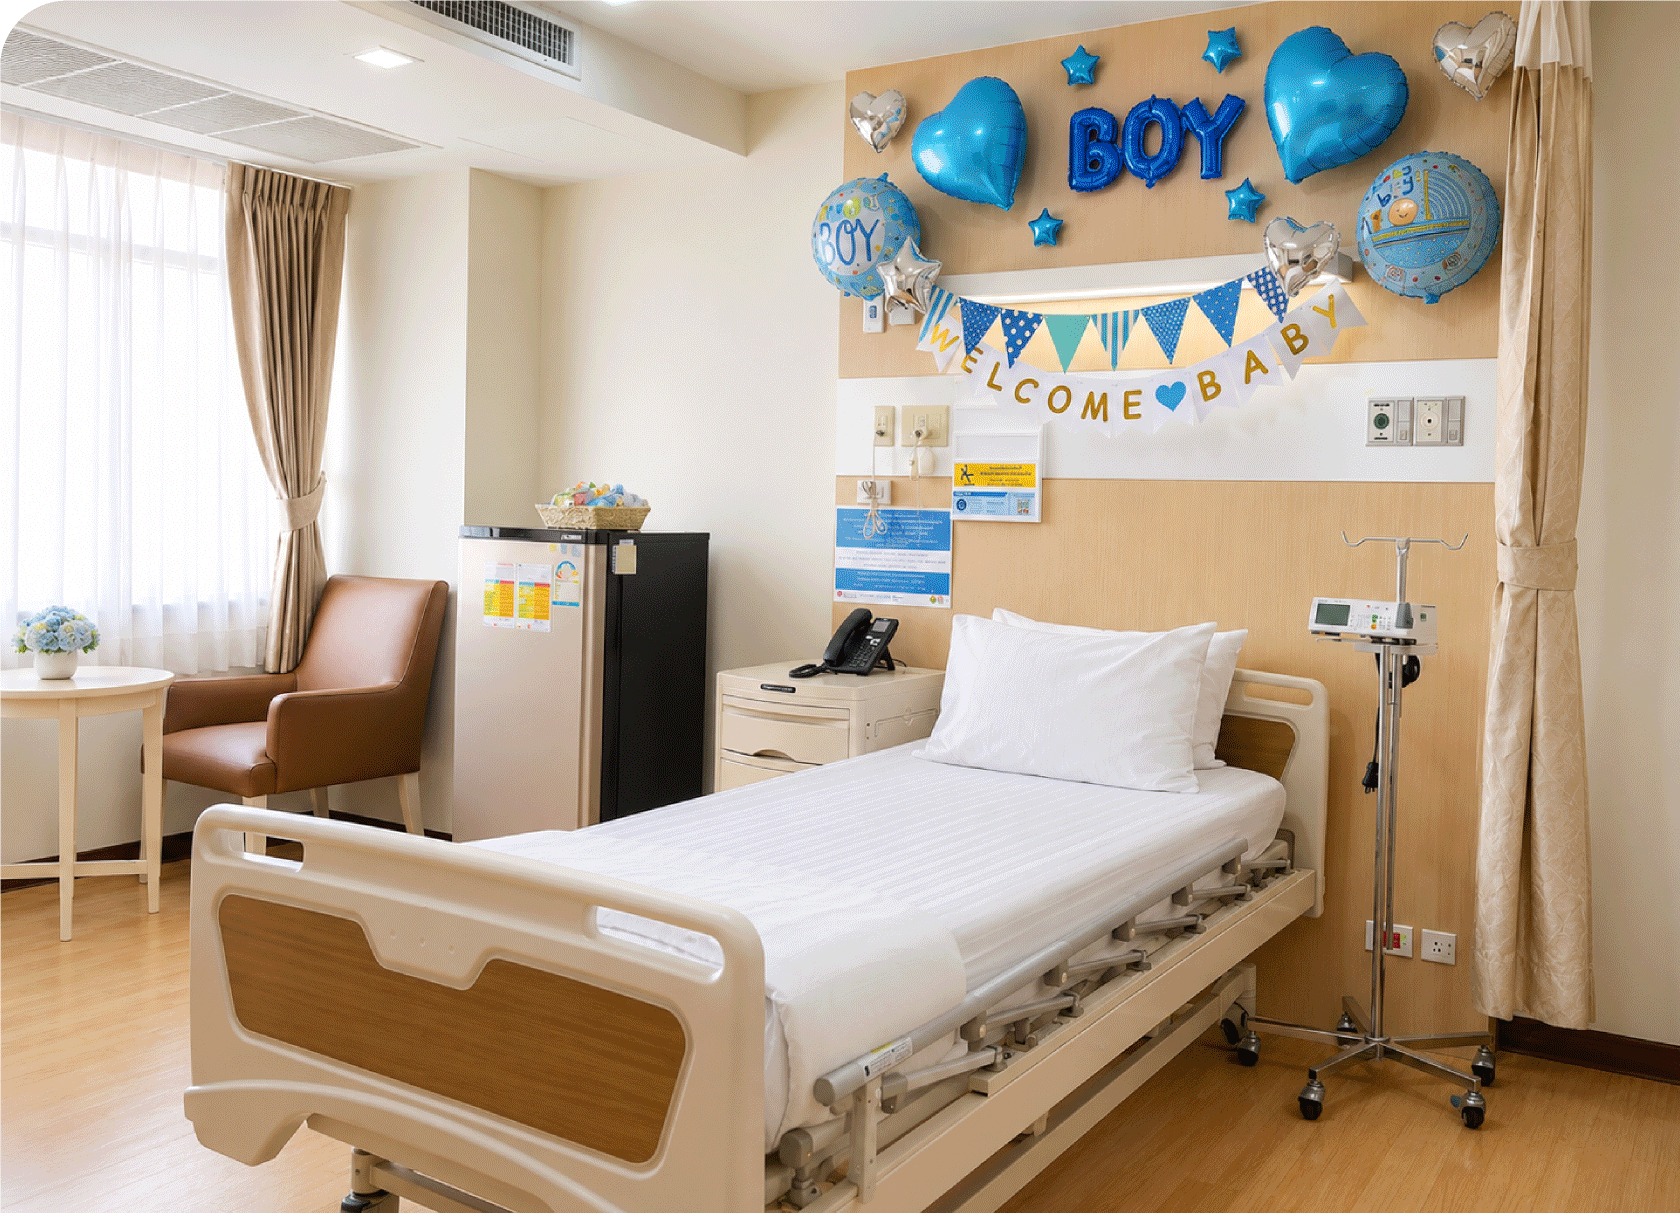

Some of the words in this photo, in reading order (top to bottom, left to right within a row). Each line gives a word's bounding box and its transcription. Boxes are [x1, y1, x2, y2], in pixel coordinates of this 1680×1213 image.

[1068, 93, 1246, 193] BOY
[819, 218, 880, 266] BOY
[929, 323, 1143, 423] WELCOME
[1196, 293, 1338, 403] BABY
